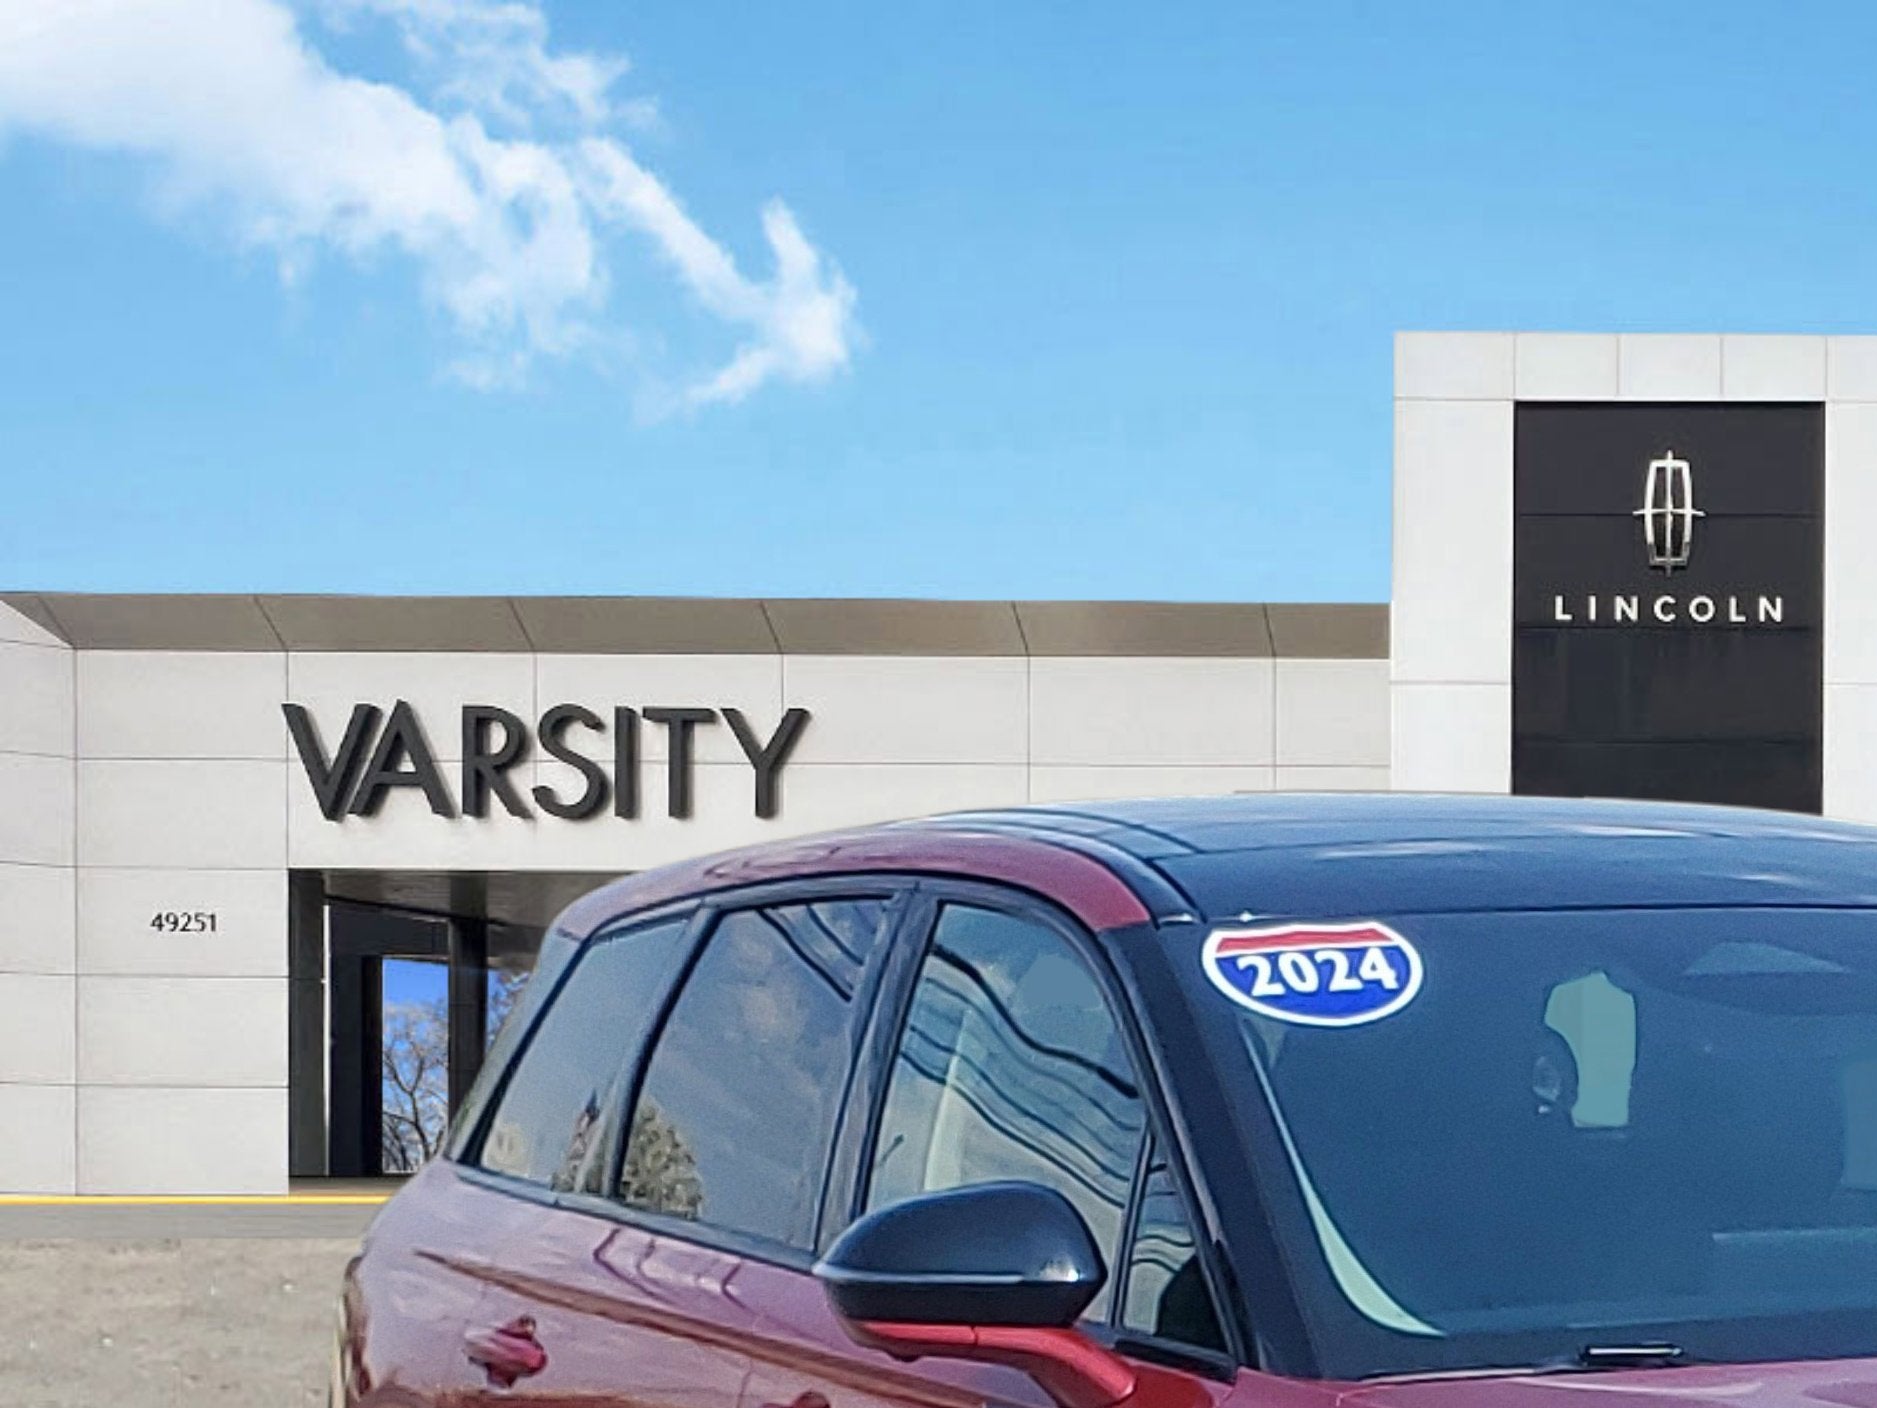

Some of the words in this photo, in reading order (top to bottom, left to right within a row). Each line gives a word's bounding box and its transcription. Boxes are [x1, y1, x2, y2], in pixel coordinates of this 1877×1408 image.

[1554, 595, 1783, 622] LINCOLN
[281, 699, 811, 823] VARSITY
[150, 911, 217, 932] 49251
[1236, 947, 1399, 997] 2024
